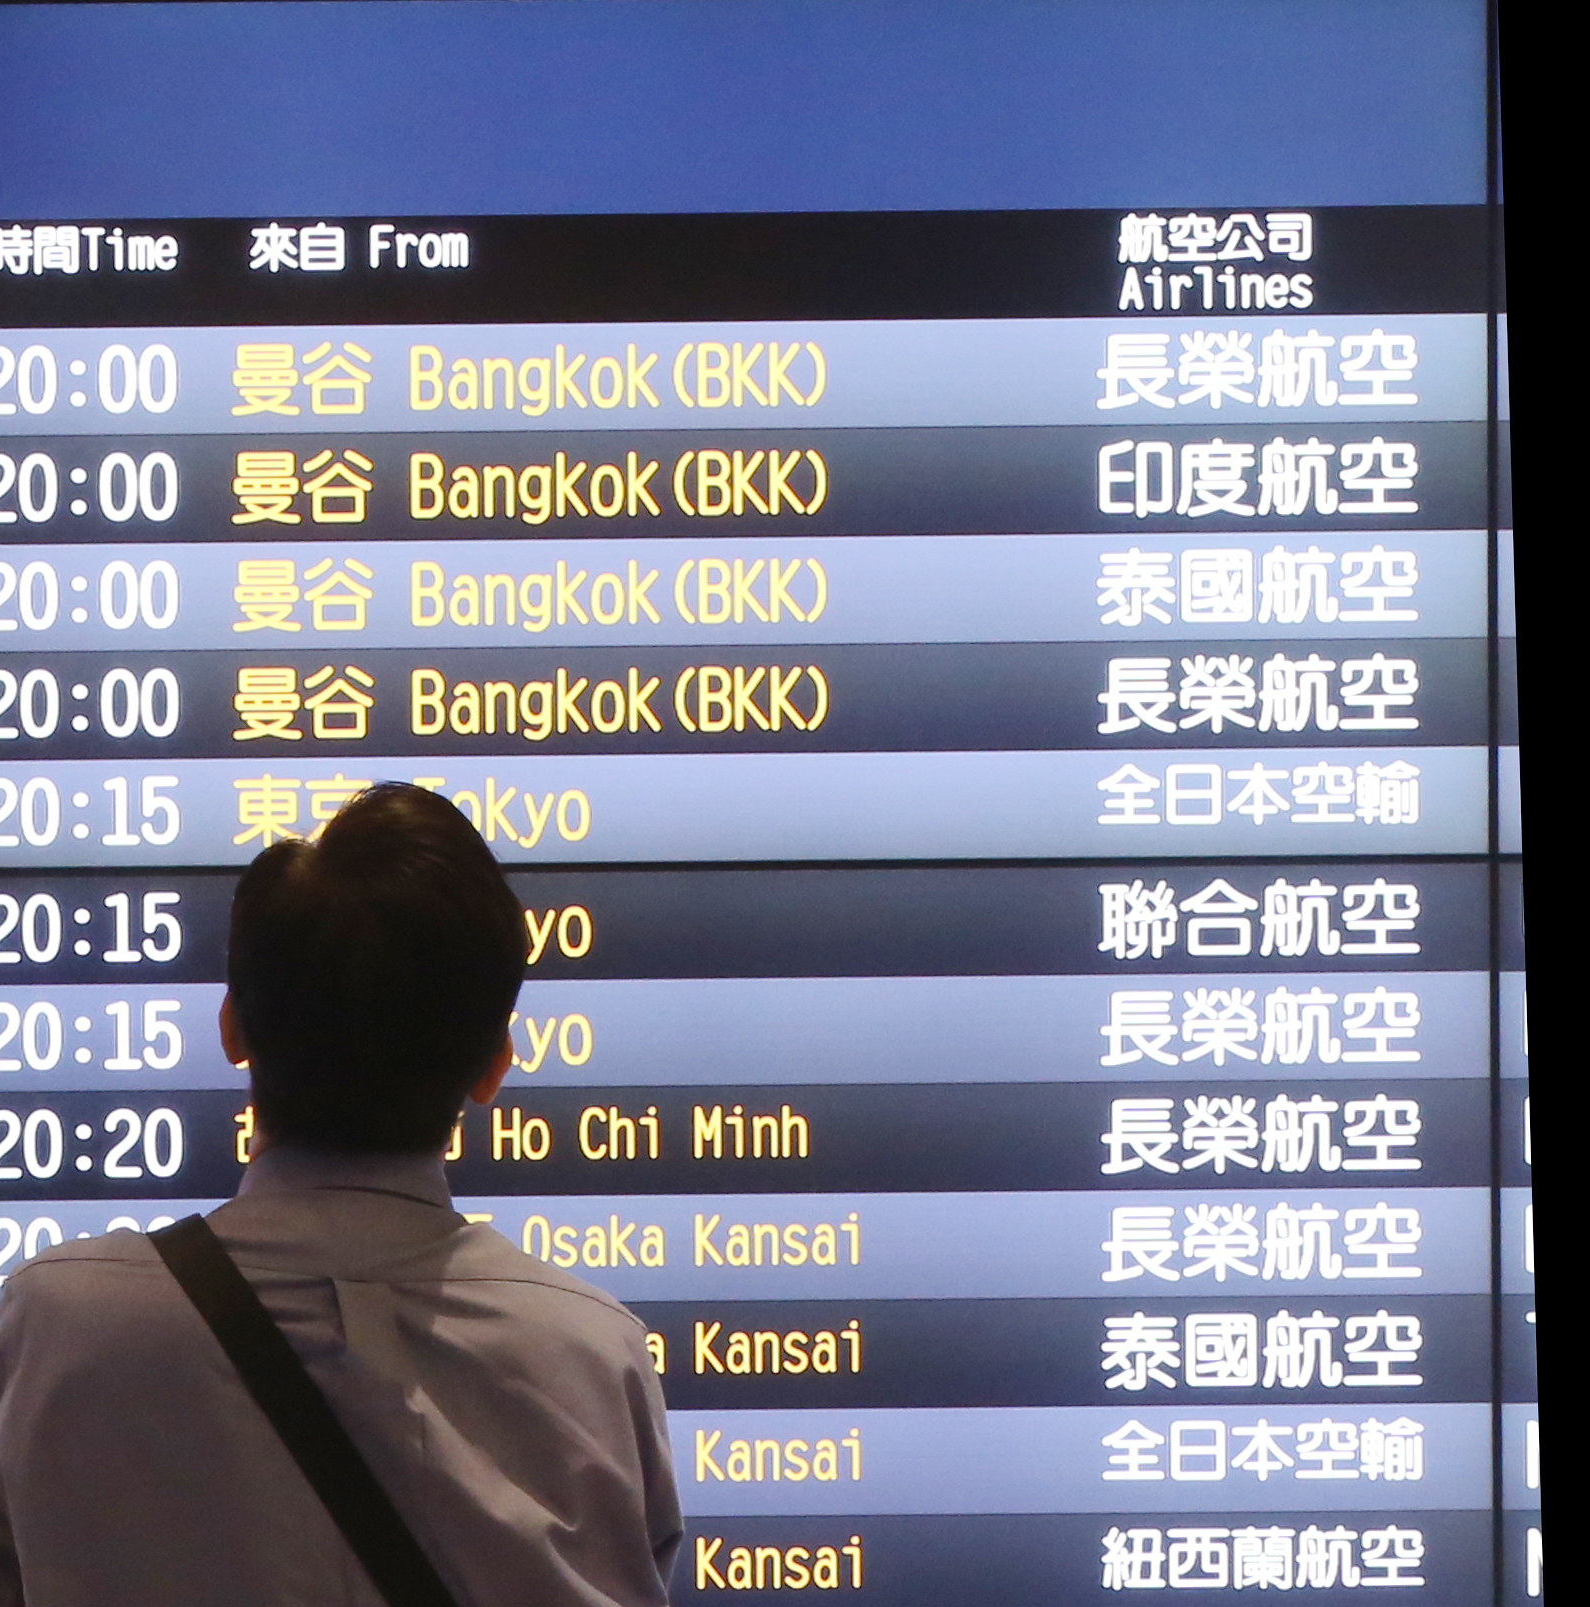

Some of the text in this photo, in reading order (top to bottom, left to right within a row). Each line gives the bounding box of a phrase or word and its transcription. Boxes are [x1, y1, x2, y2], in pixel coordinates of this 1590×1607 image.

[249, 221, 469, 273] 來自 From
[1117, 212, 1313, 264] 航空公司
[1118, 265, 1314, 311] Airlines
[231, 448, 373, 525] 曼谷
[1098, 435, 1419, 519] 印度航空
[232, 664, 375, 741] 曼谷
[1097, 652, 1420, 735] 長榮航空
[1097, 877, 1421, 960] 聯合航空
[492, 1104, 808, 1161] Ho Chi Minh
[1100, 1093, 1422, 1175] 長榮航空
[522, 1211, 860, 1269] Osaka Kansai
[694, 1319, 860, 1375] Kansai
[1100, 1308, 1424, 1391] 泰國航空
[1100, 1415, 1425, 1482] 全日本空輸
[696, 1535, 862, 1590] Kansai
[1100, 1524, 1425, 1591] 紐西蘭航空
